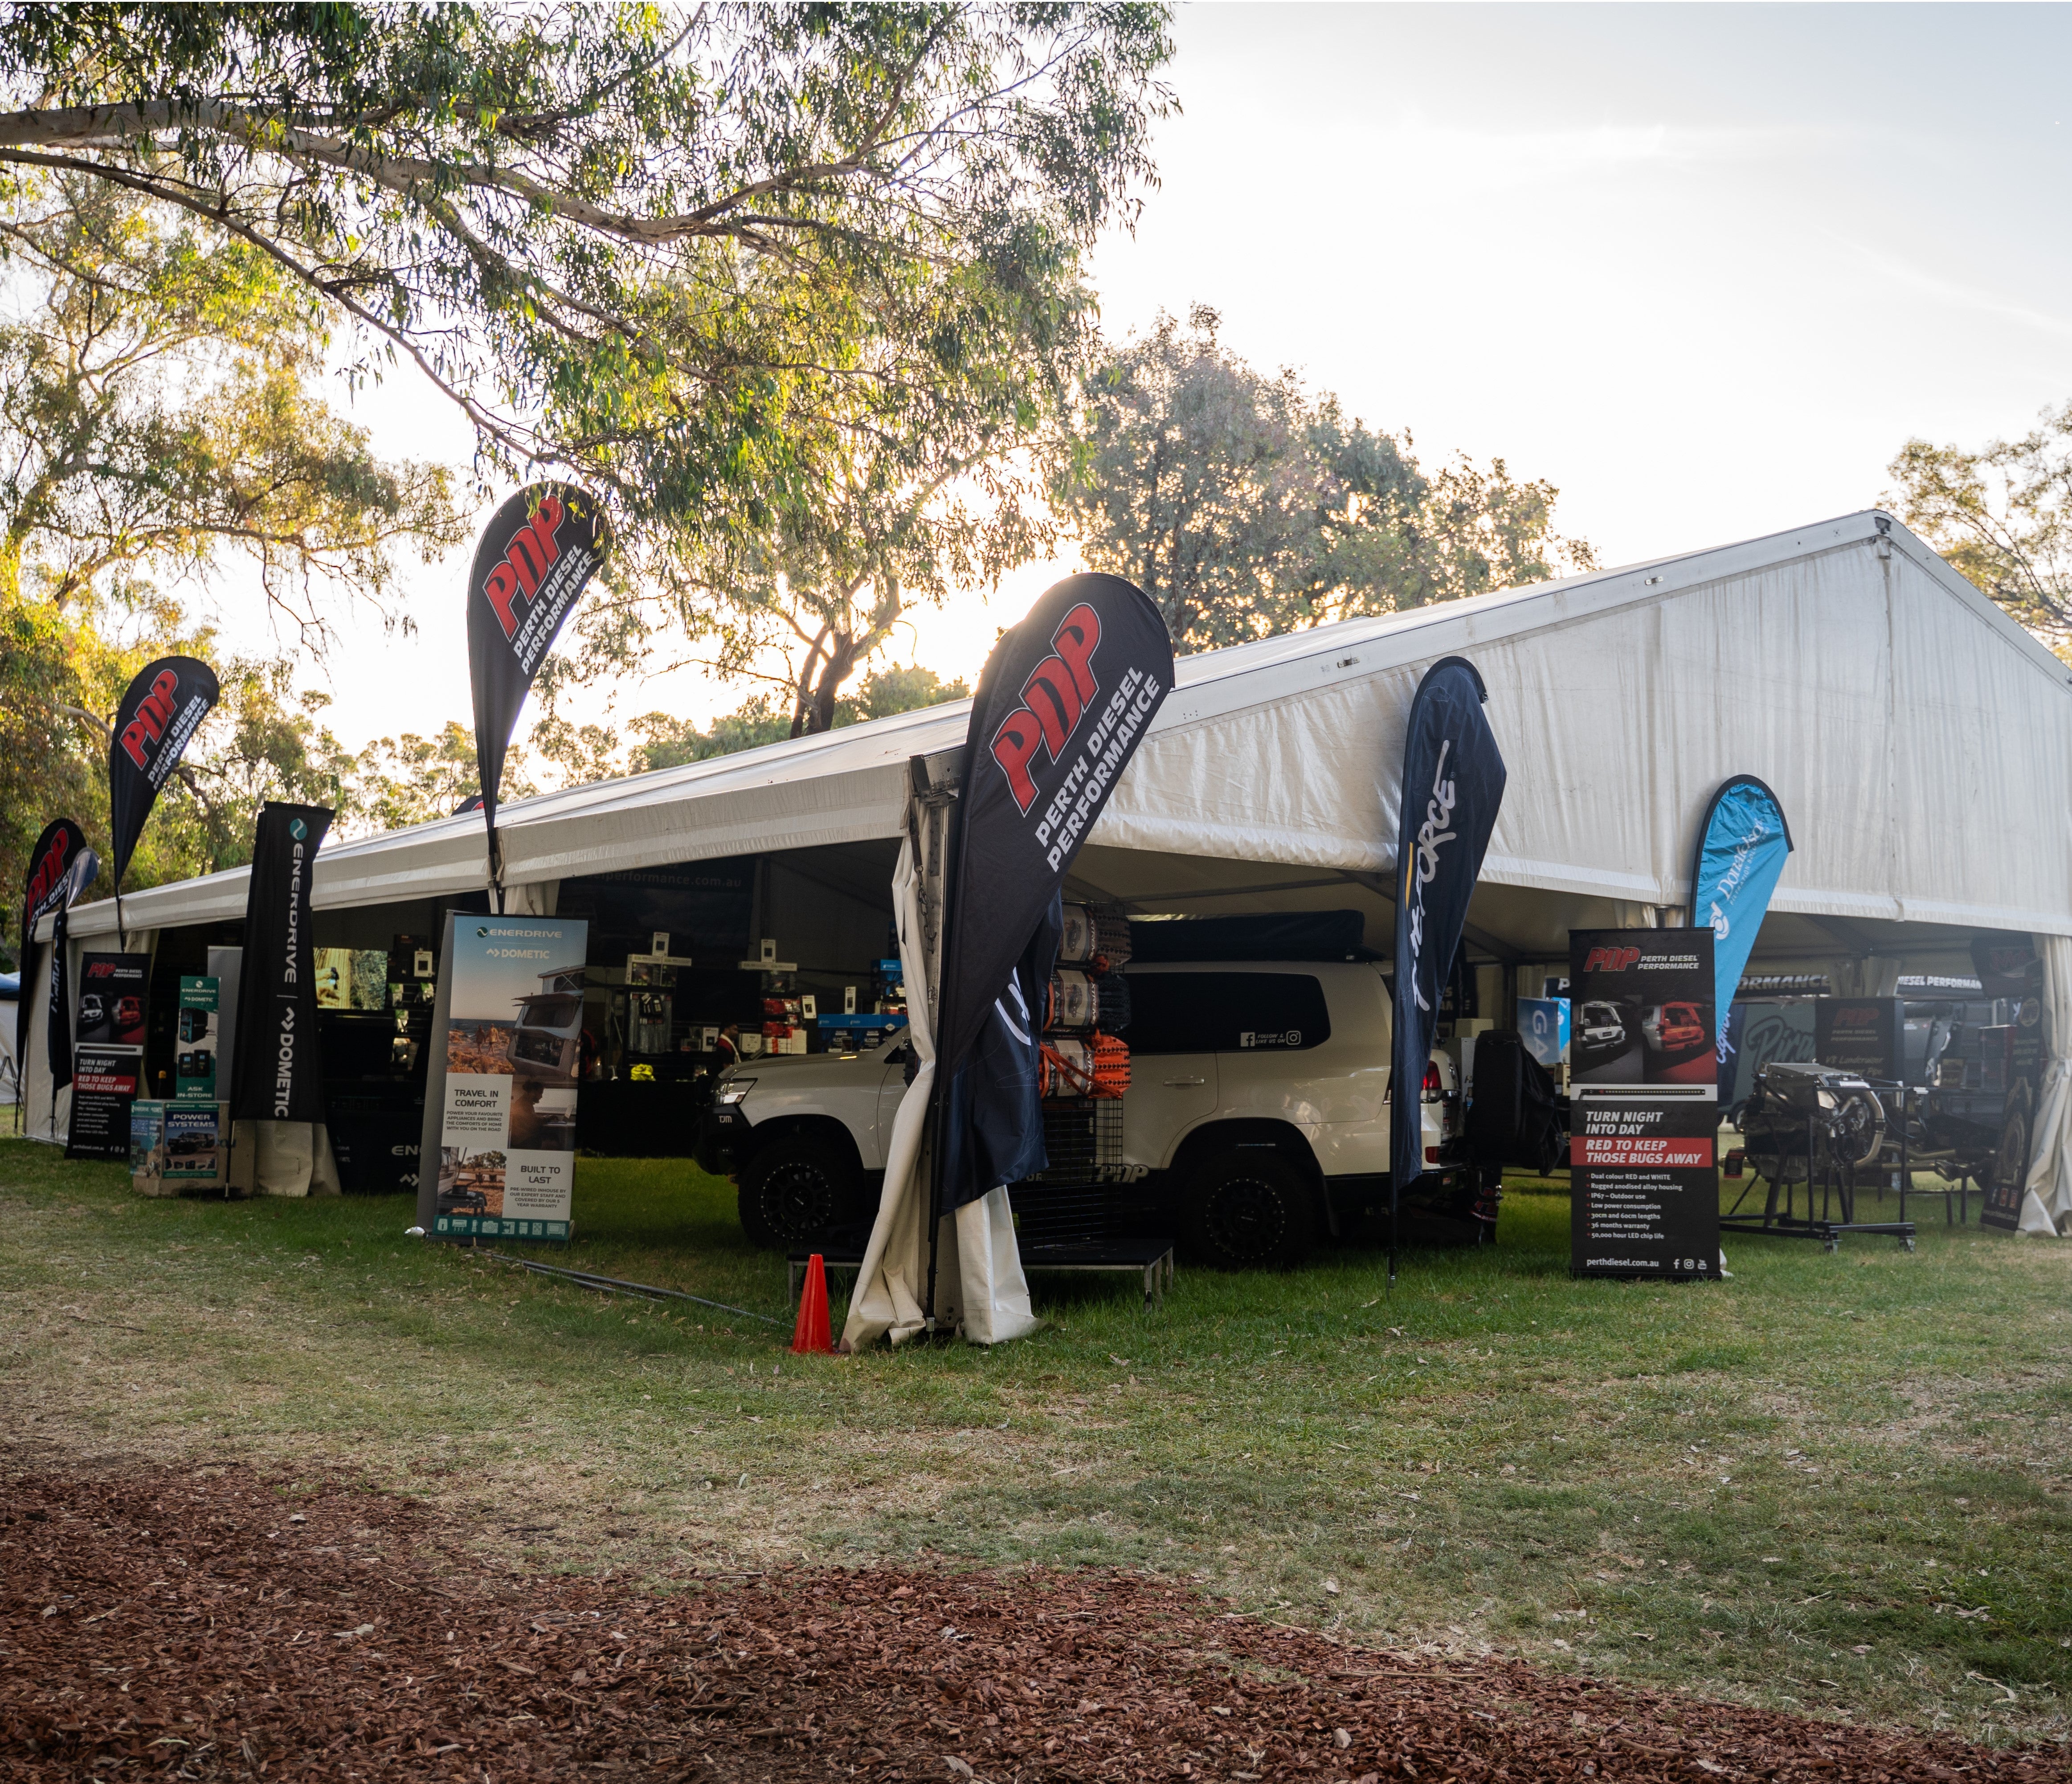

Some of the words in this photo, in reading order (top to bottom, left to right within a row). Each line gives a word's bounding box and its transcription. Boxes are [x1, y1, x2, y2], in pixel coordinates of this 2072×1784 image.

[482, 494, 565, 642] PDP
[513, 599, 547, 658] PERTH
[544, 545, 583, 601] DIESEL
[521, 551, 594, 675] PERFORMANCE
[119, 669, 178, 771] PDP
[148, 737, 172, 782] PERTH
[171, 695, 201, 737] DIESEL
[153, 699, 209, 790] PERFORMANCE
[989, 602, 1101, 818] PDP
[1034, 755, 1089, 847] PERTH
[1087, 667, 1144, 757] DIESEL
[1046, 674, 1160, 872] PERFORMANCE
[26, 827, 69, 931] PDP
[284, 843, 304, 983] ENERDRIVE
[489, 929, 562, 938] ENERDRIVE
[501, 949, 550, 959] DOMETIC
[1583, 947, 1640, 972] PDP
[274, 1034, 294, 1118] DOMETIC
[455, 1100, 497, 1108] COMFORT
[1586, 1112, 1620, 1121] TURN
[1623, 1112, 1663, 1122] NIGHT
[1586, 1124, 1617, 1134] INTO
[1619, 1125, 1644, 1134] DAY
[1586, 1140, 1612, 1150] RED
[1616, 1141, 1632, 1150] TO
[1635, 1141, 1667, 1151] KEEP
[1586, 1153, 1627, 1163] THOSE
[1629, 1153, 1663, 1163] BUGS
[1664, 1154, 1702, 1164] AWAY
[1586, 1258, 1659, 1267] perthdiesel.com.au
